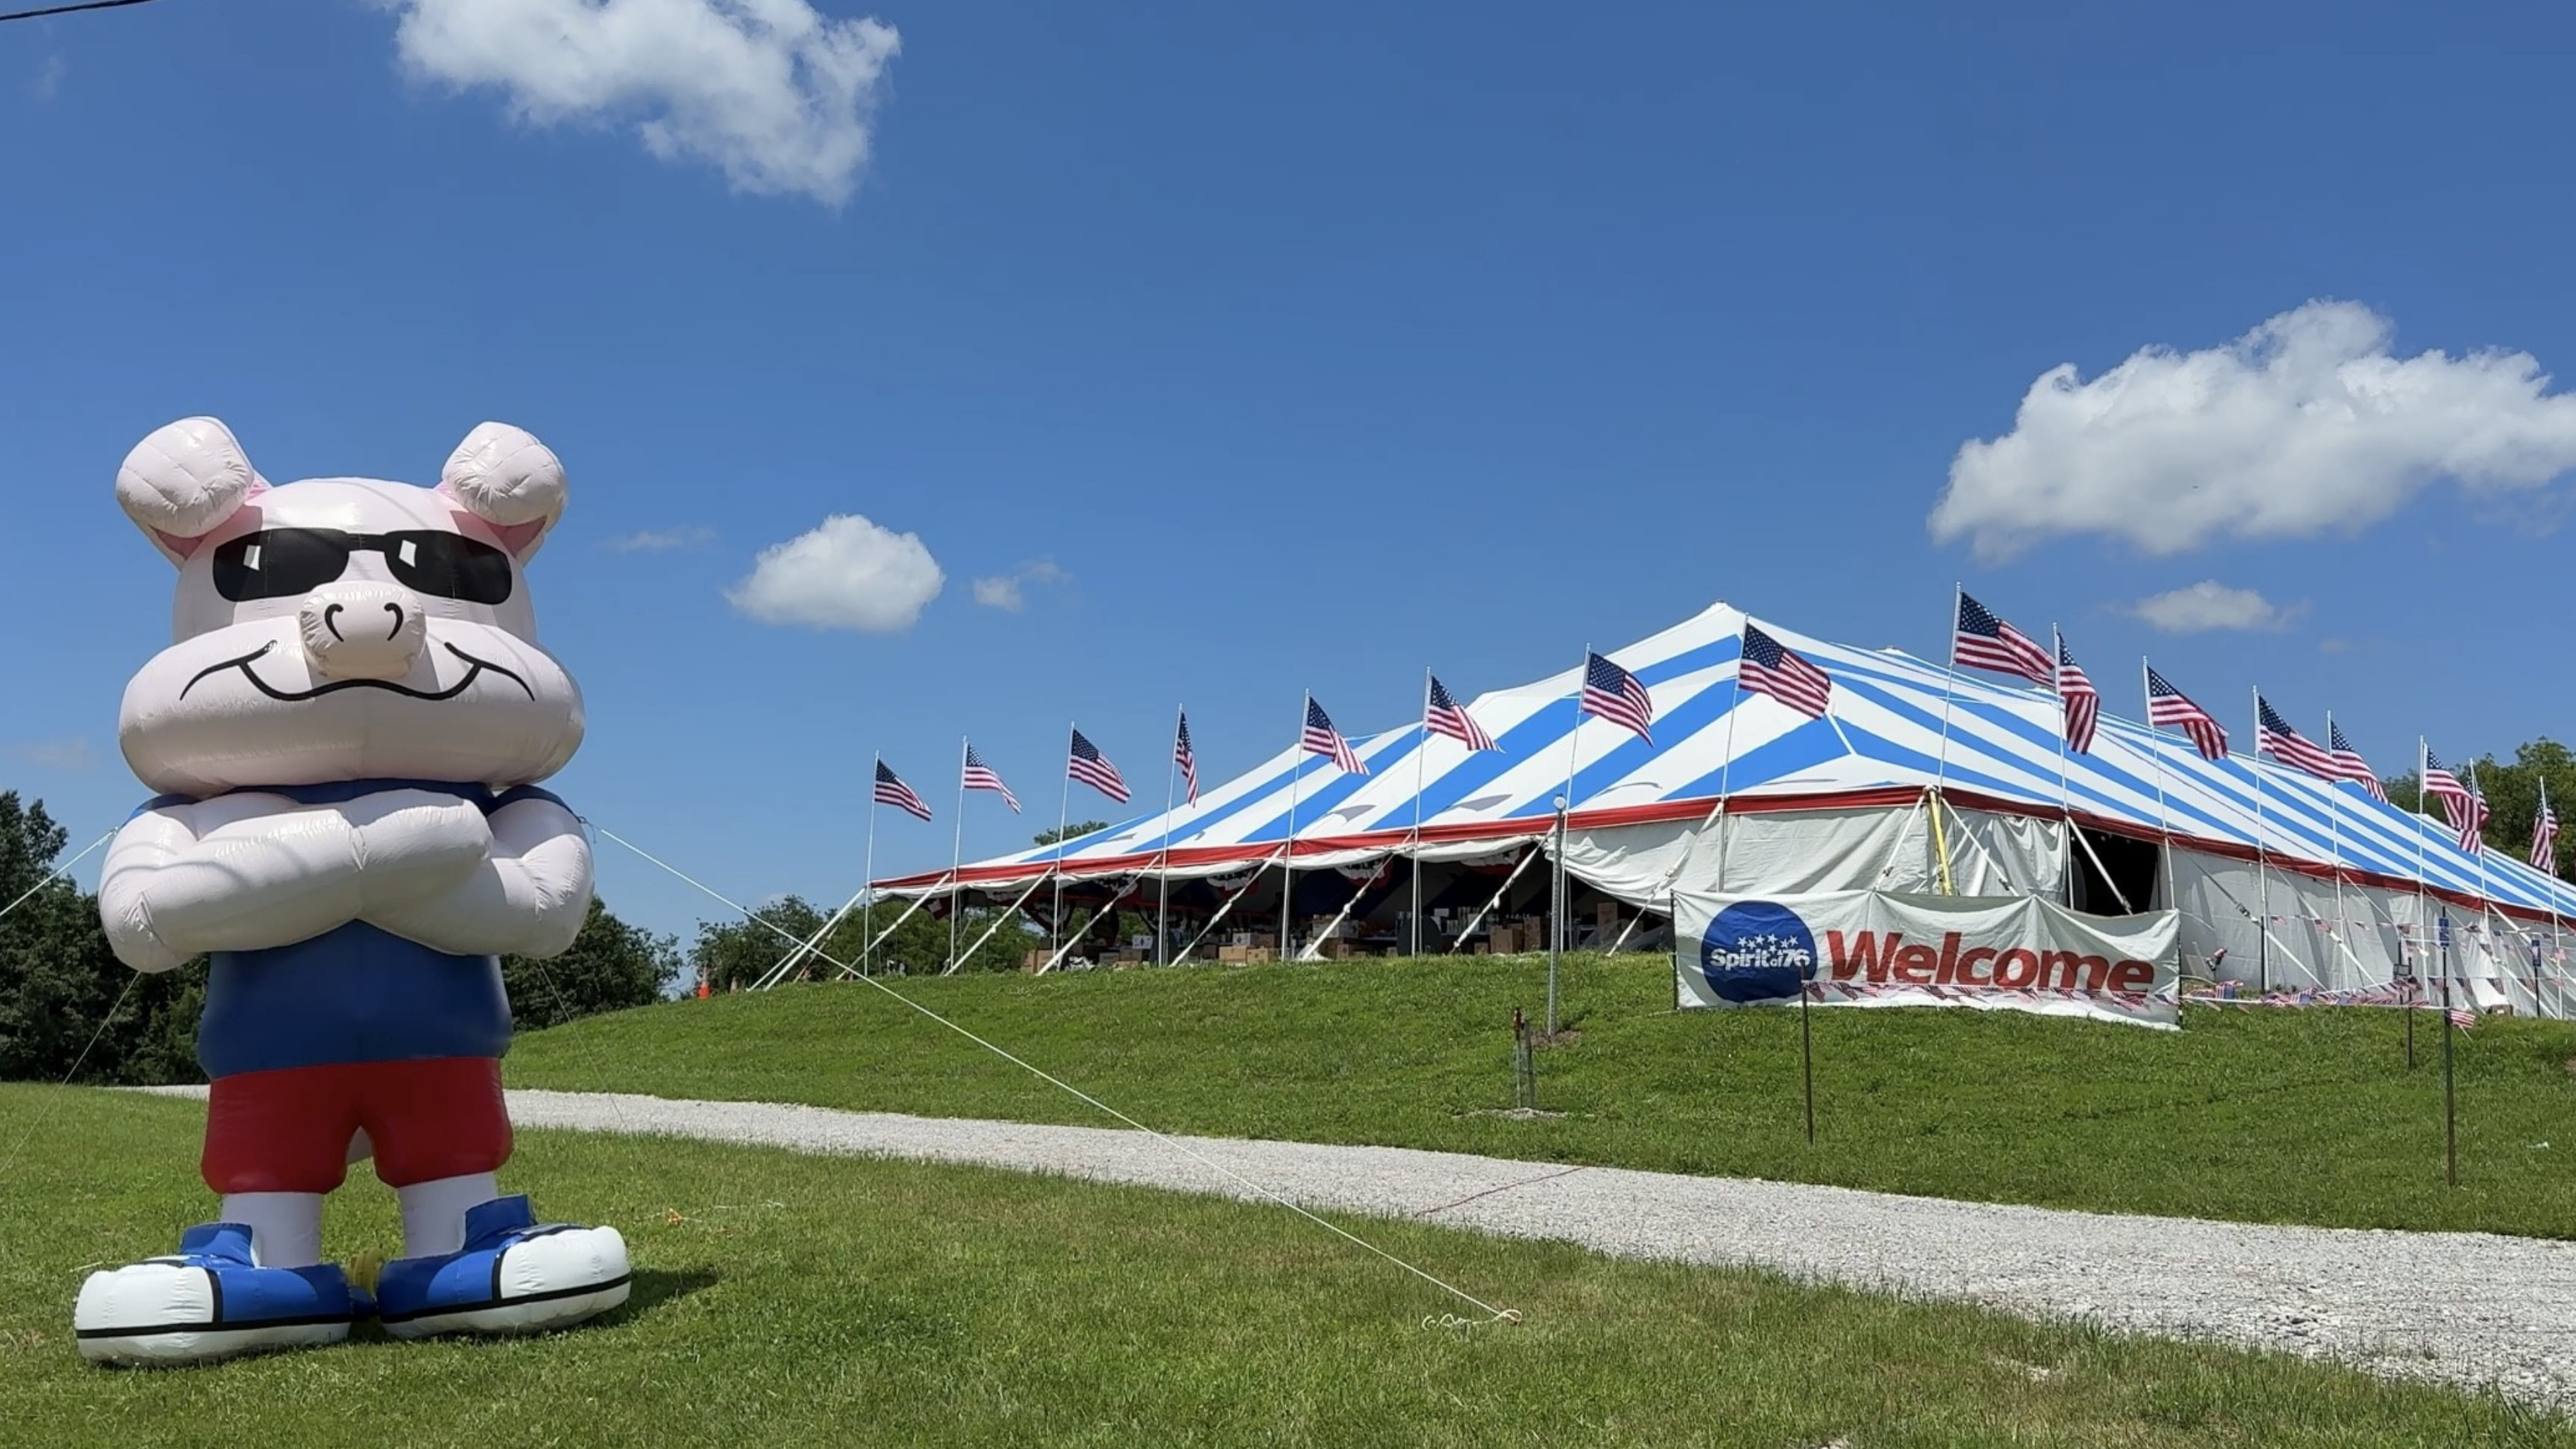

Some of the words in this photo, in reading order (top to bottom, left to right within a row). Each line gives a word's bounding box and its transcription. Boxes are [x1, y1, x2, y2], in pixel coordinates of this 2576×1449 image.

[1710, 948, 1770, 971] Spirit
[1770, 955, 1784, 967] of
[1826, 930, 2154, 995] Welcome
